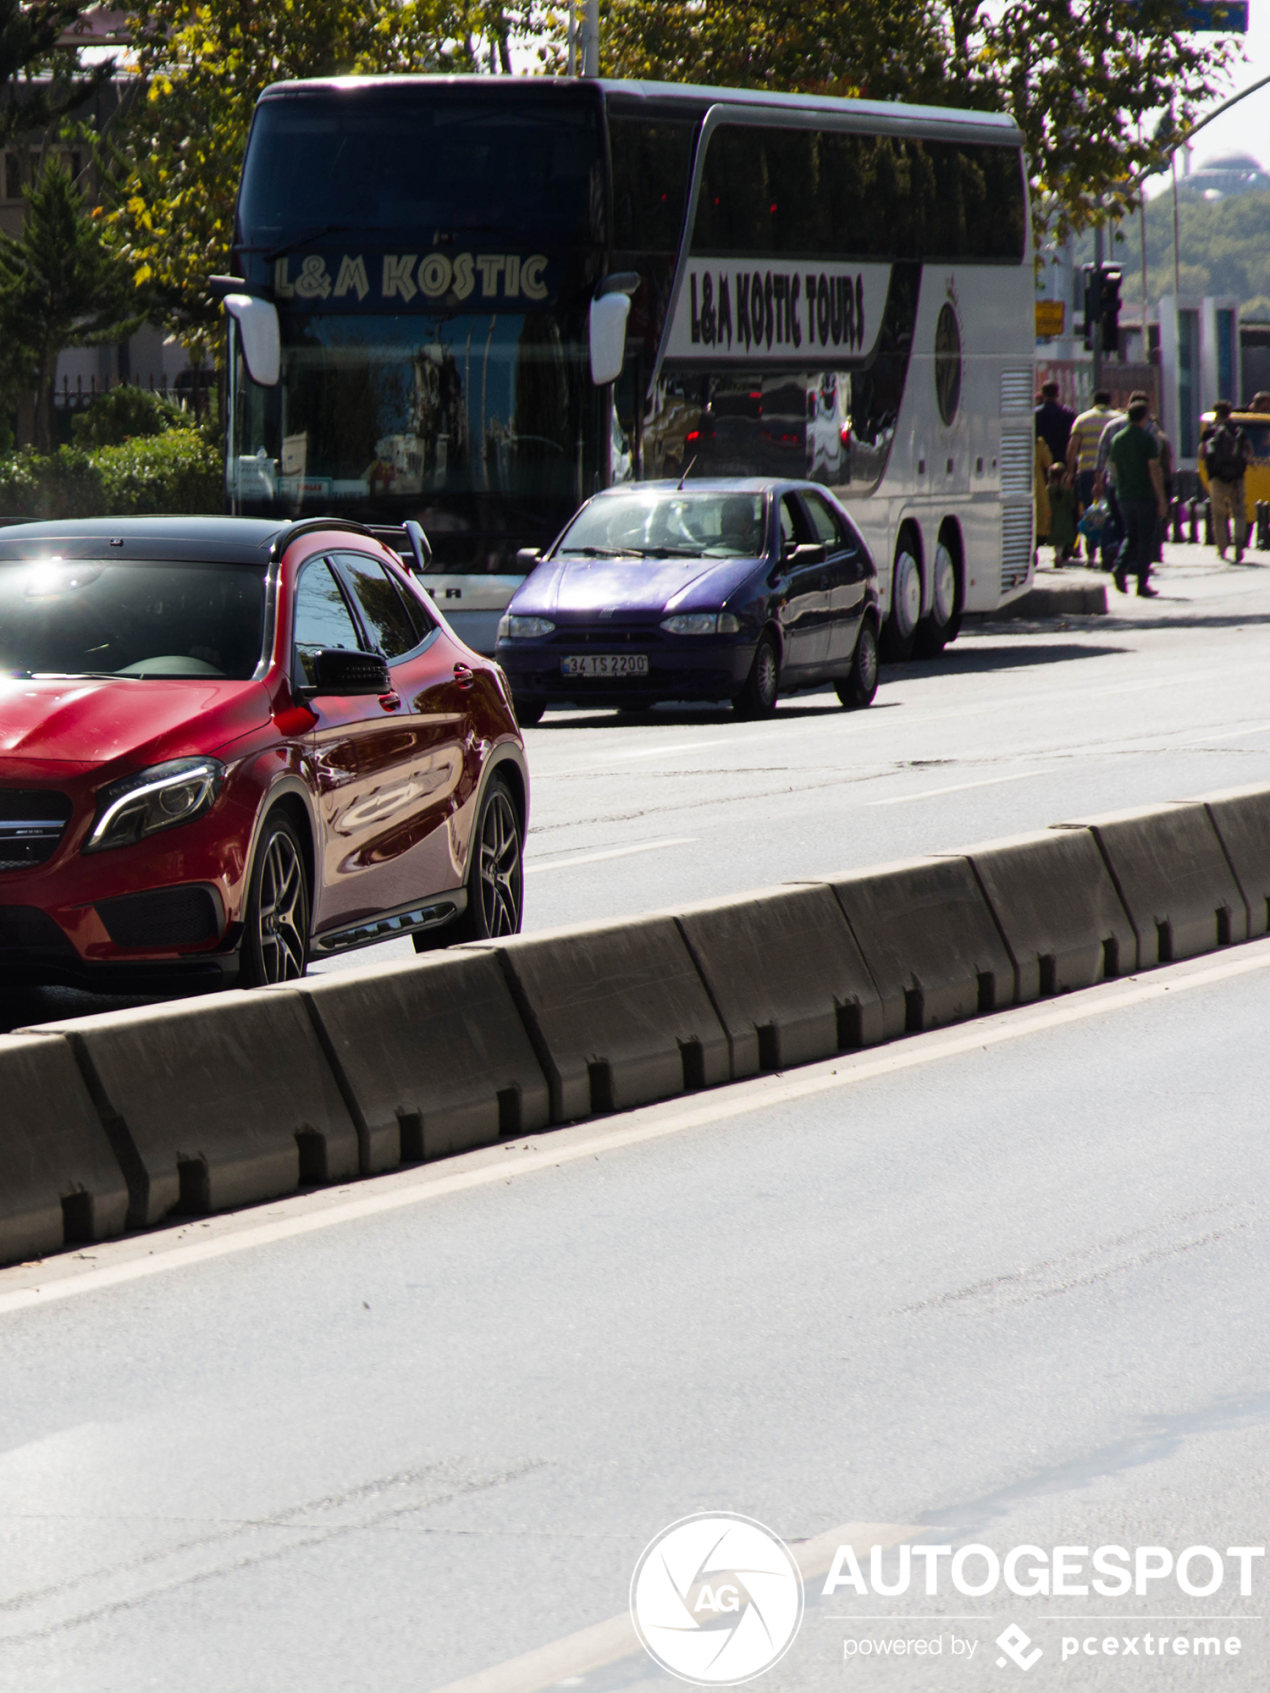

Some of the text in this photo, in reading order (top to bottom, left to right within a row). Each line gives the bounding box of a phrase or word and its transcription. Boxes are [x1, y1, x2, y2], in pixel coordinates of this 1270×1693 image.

[274, 252, 549, 302] L&M KOSTIC
[690, 269, 865, 354] L&M KOSTIC TOURS
[570, 656, 645, 672] 34 TS 2200
